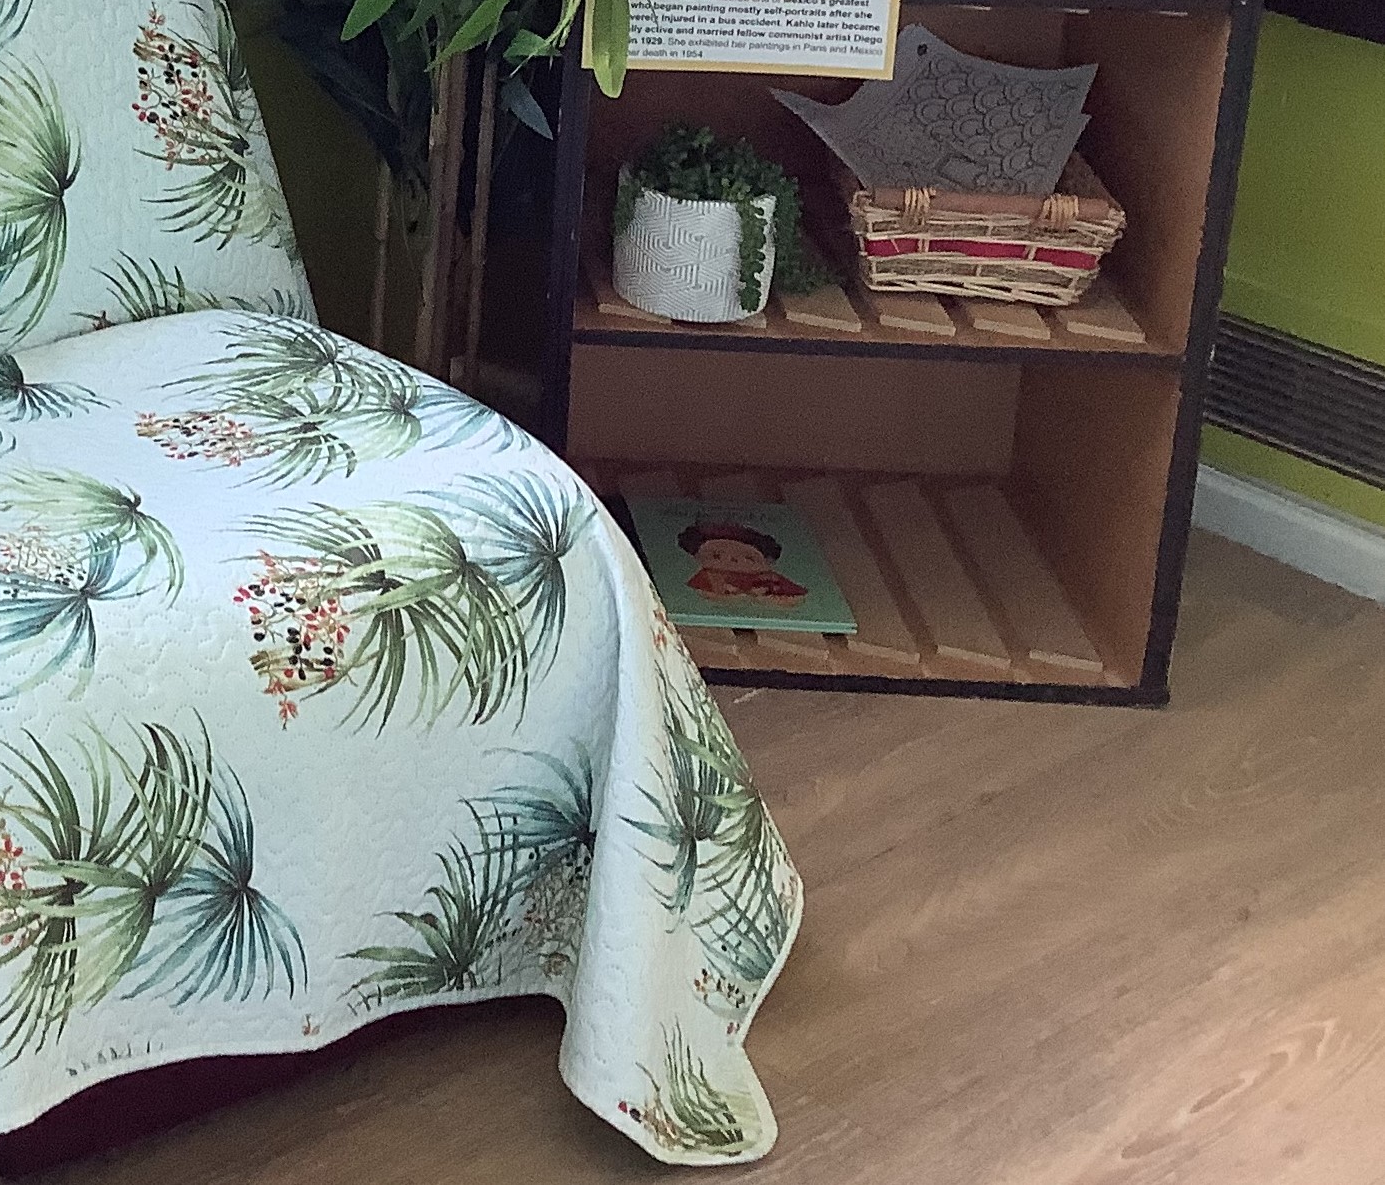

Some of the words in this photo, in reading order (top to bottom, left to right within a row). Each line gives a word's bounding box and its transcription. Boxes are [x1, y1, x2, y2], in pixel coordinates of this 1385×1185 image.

[653, 2, 684, 12] began
[685, 3, 726, 14] painting
[728, 5, 761, 16] mostly
[764, 6, 827, 17] self-portraits
[829, 9, 852, 18] after
[854, 10, 873, 19] she
[661, 14, 695, 23] injured
[718, 16, 736, 24] bus
[786, 19, 814, 28] Kahlo
[817, 20, 839, 29] later
[842, 22, 881, 31] became
[675, 26, 694, 34] and
[696, 28, 734, 36] married
[736, 28, 765, 37] fellow
[768, 31, 823, 41] communist
[825, 33, 851, 42] artist
[853, 34, 883, 45] Diego
[749, 41, 790, 52] paintings
